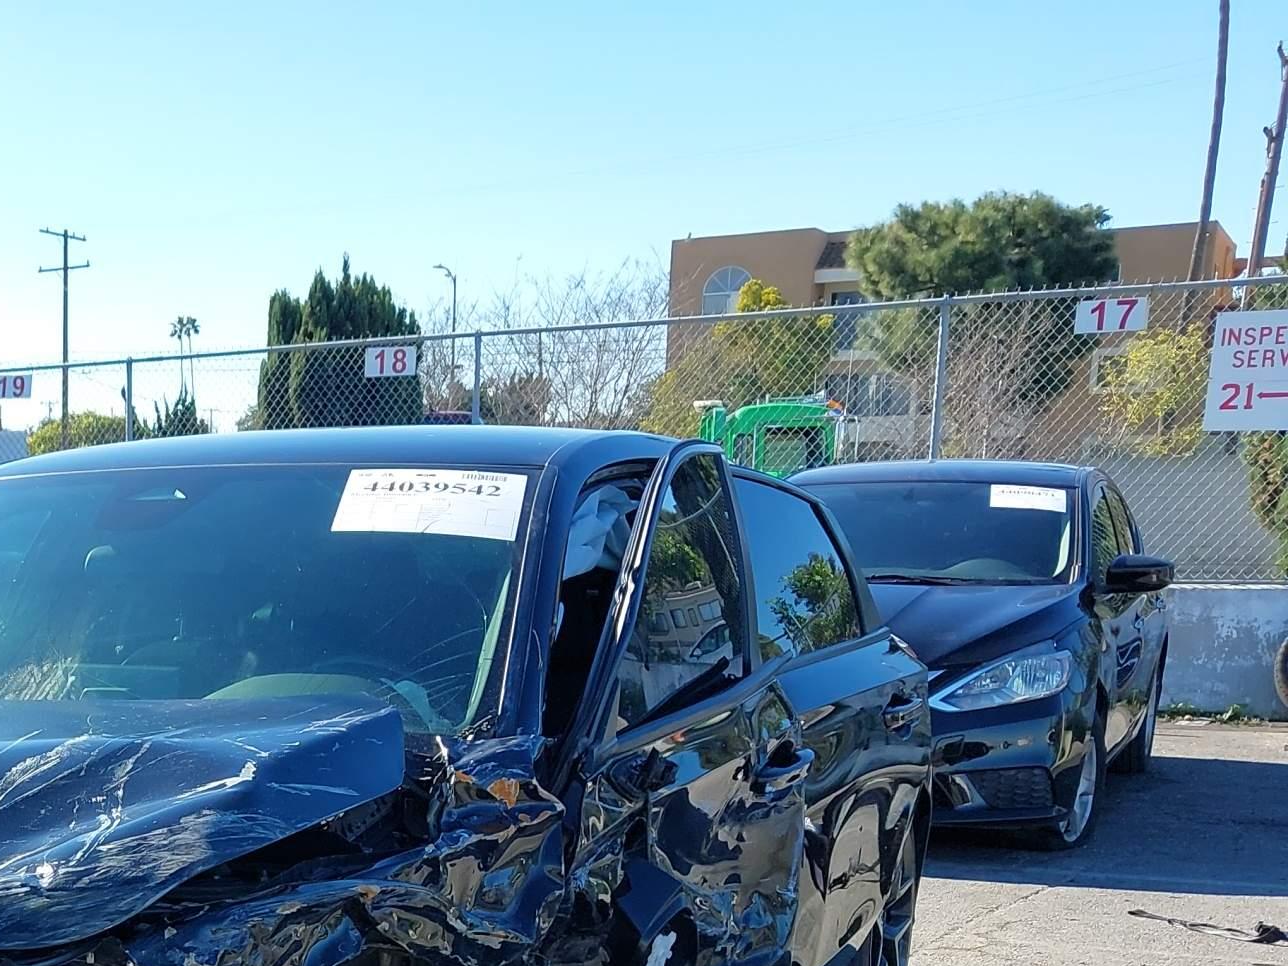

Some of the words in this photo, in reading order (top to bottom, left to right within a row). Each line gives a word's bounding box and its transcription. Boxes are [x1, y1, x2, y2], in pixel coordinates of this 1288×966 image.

[1090, 299, 1139, 331] 17
[1220, 325, 1288, 347] INSPE
[374, 348, 407, 375] 18
[1219, 382, 1254, 410] 21
[363, 481, 502, 497] 44039542
